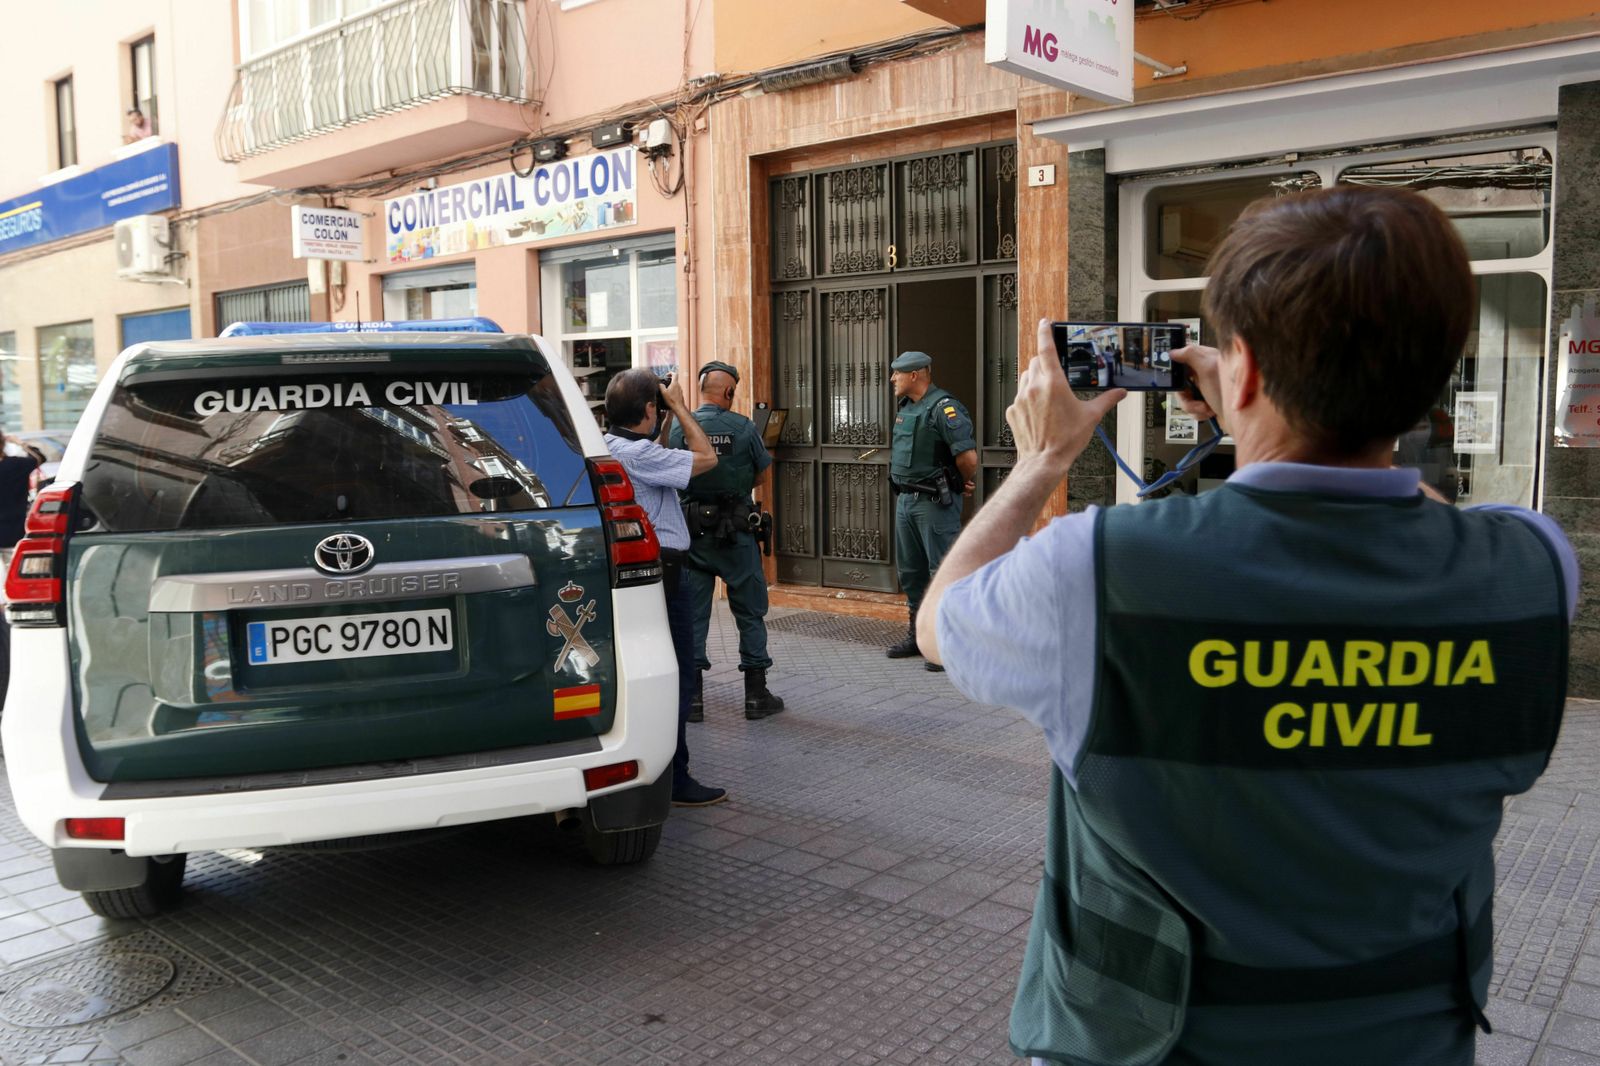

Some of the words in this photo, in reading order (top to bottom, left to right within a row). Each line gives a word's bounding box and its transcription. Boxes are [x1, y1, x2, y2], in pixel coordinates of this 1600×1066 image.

[1023, 25, 1058, 62] MG
[389, 175, 525, 234] COMERCIAL
[534, 149, 632, 206] COLON
[1038, 169, 1045, 182] 3
[302, 213, 359, 229] COMERCIAL
[887, 245, 897, 268] 3
[1568, 339, 1600, 354] MG
[194, 382, 372, 416] GUARDIA
[385, 381, 478, 406] CIVIL
[226, 583, 312, 605] LAND
[324, 572, 461, 599] CRUISER
[271, 624, 332, 657] PGC
[341, 618, 421, 651] 9780
[428, 615, 448, 646] N
[1188, 639, 1495, 688] GUARDIA
[1263, 702, 1432, 749] CIVIL
